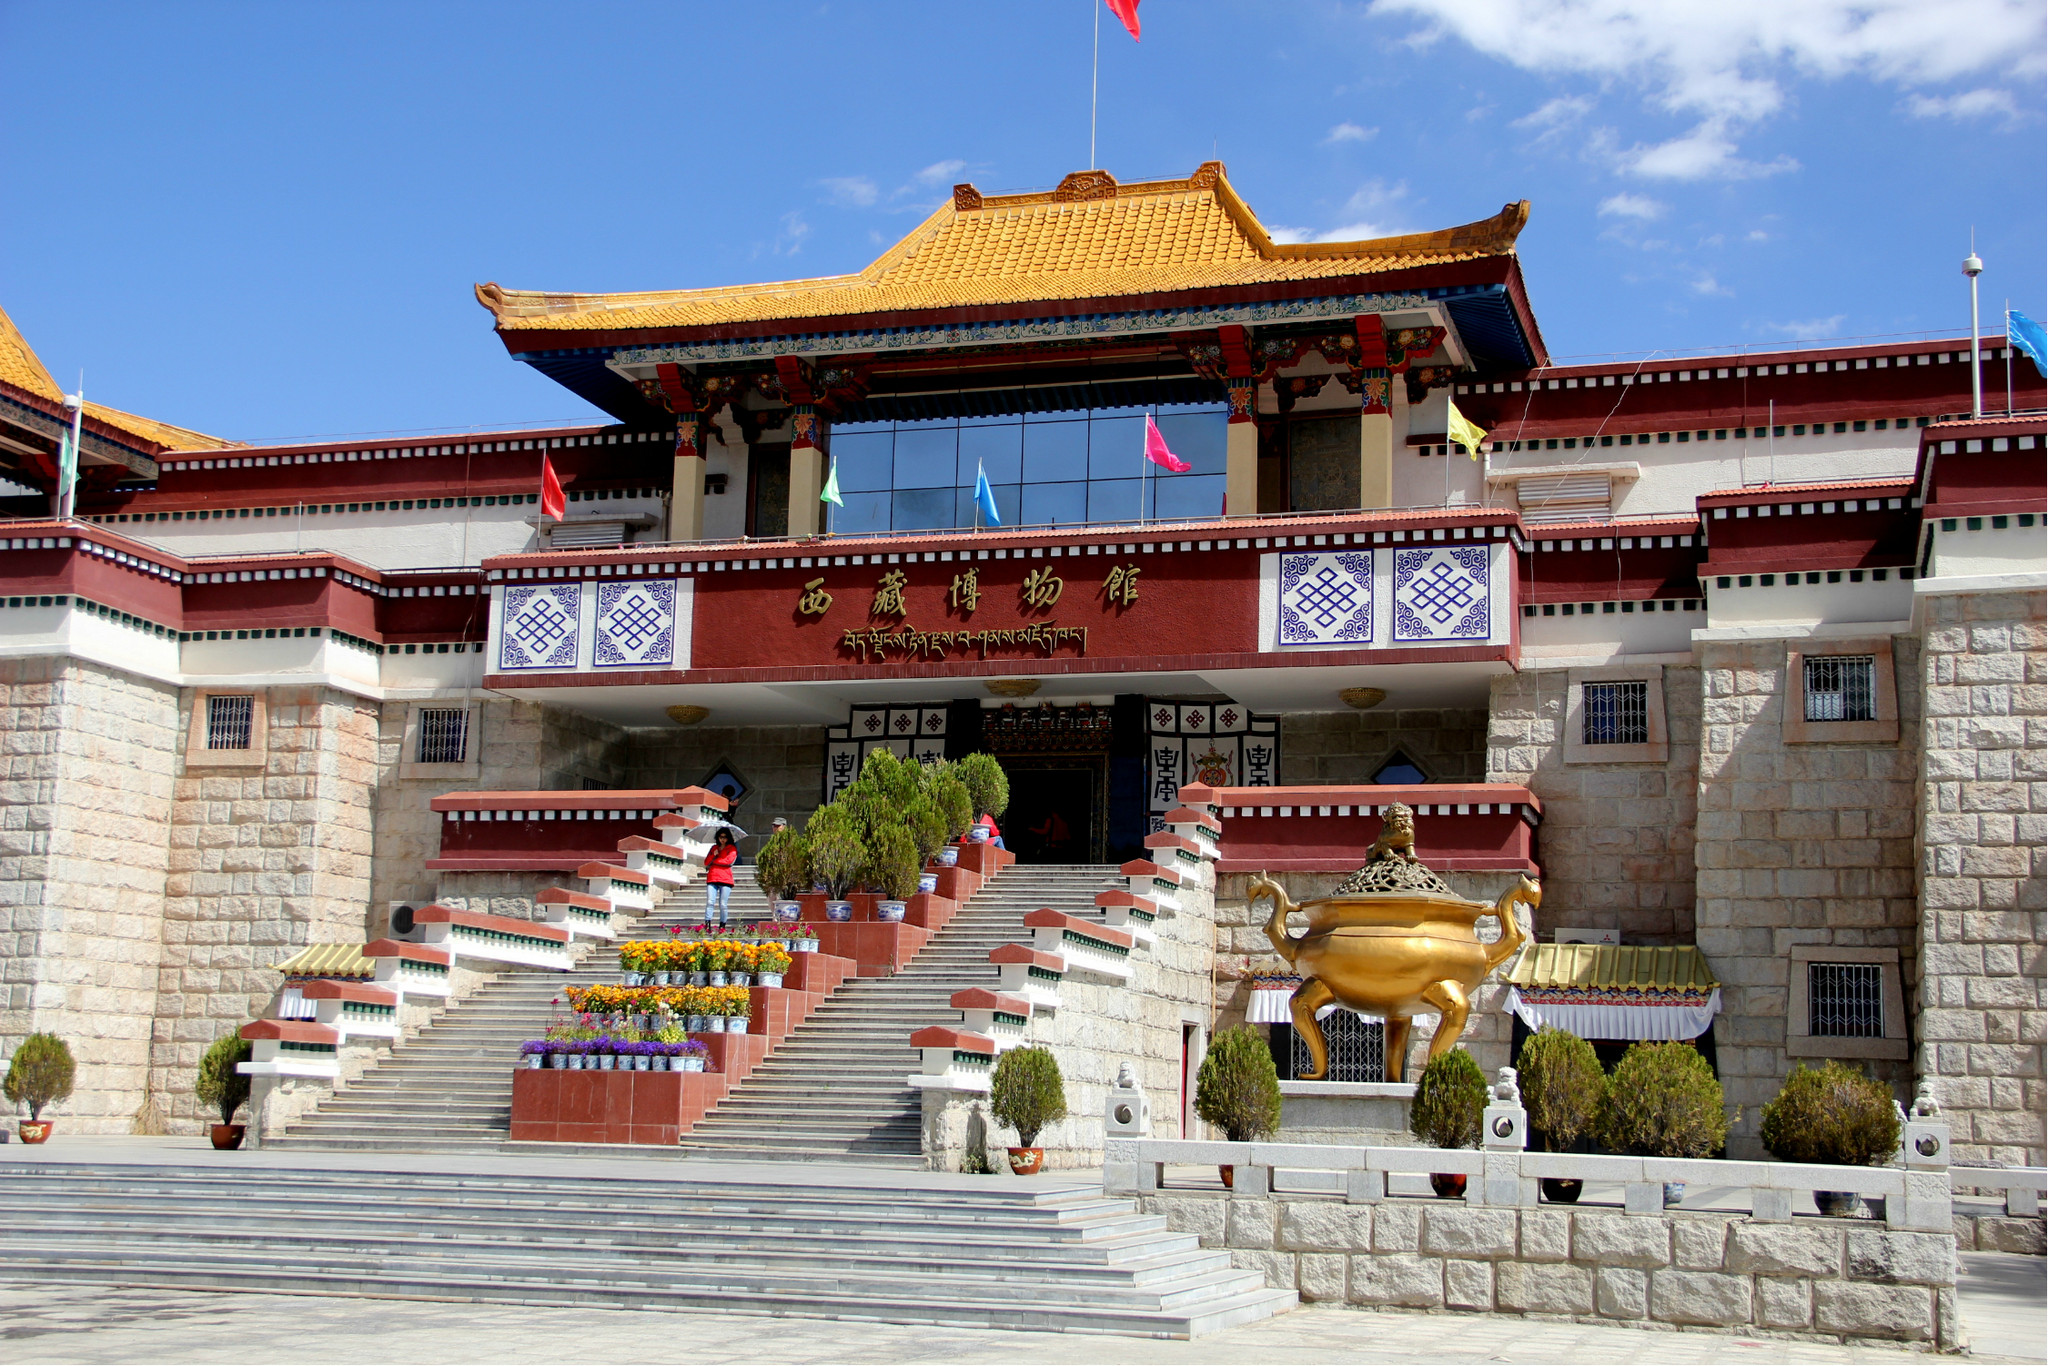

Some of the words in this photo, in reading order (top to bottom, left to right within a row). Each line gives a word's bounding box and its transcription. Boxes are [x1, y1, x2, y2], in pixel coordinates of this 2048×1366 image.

[799, 563, 1141, 616] 西藏博物館
